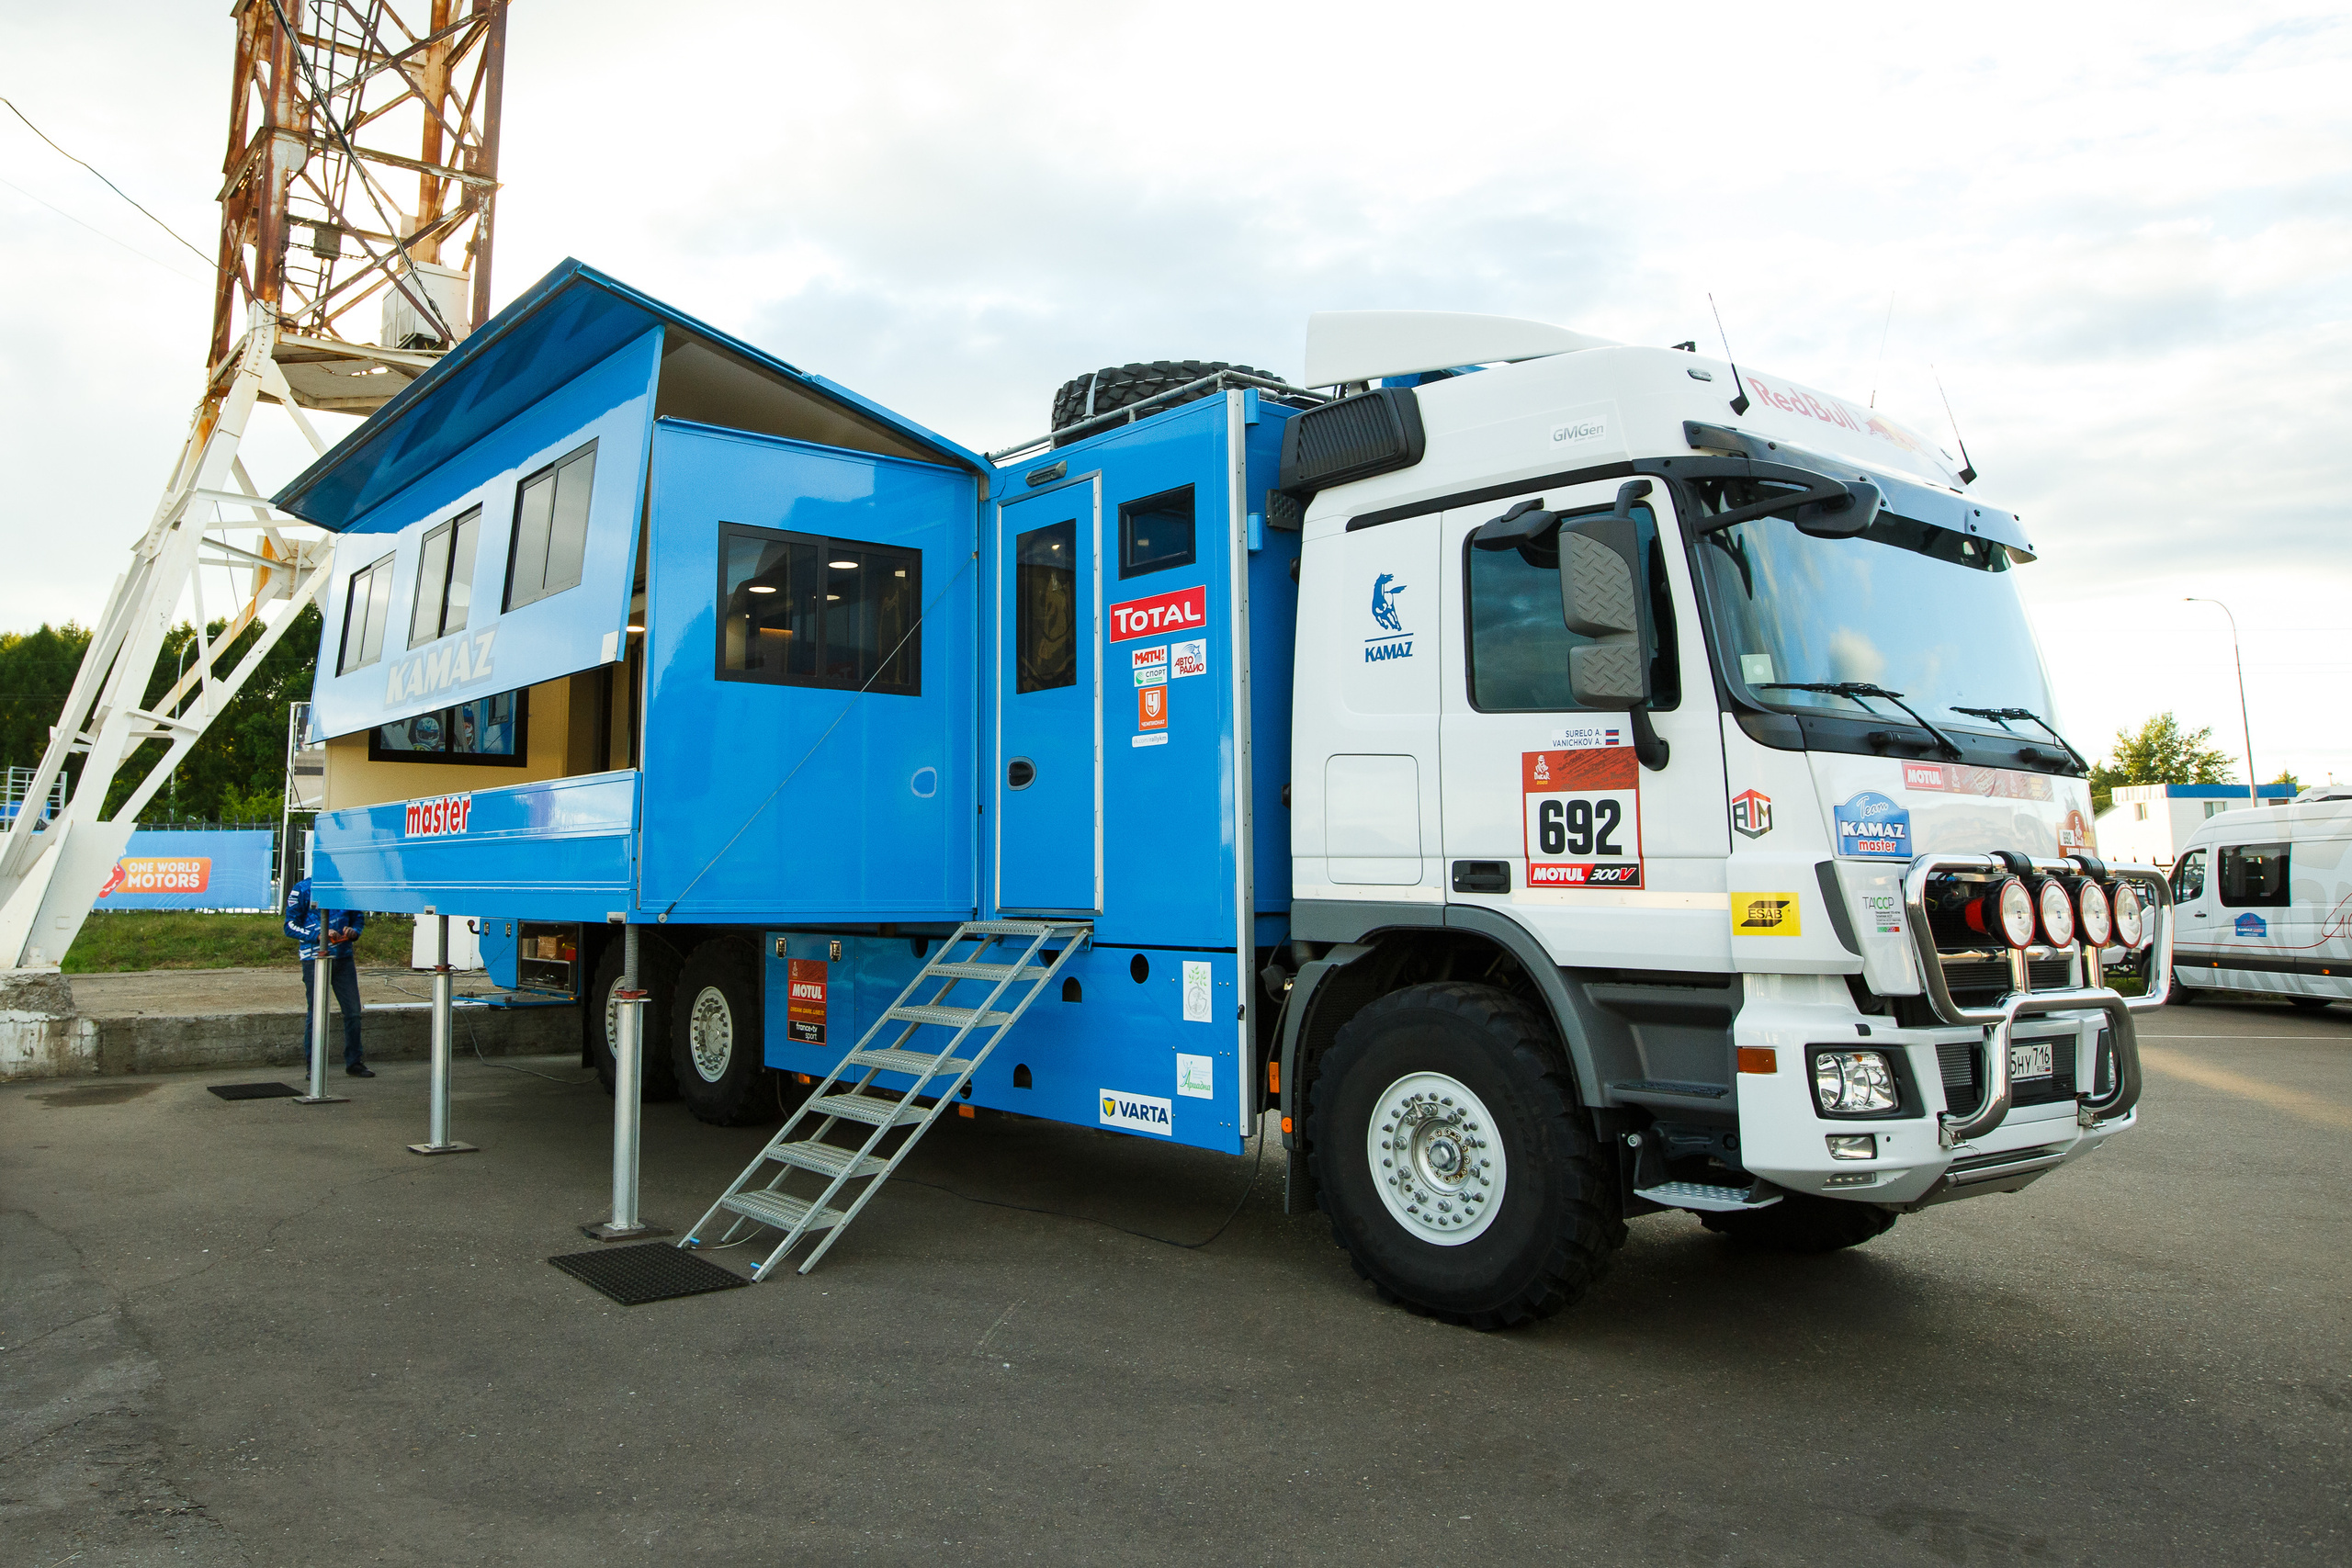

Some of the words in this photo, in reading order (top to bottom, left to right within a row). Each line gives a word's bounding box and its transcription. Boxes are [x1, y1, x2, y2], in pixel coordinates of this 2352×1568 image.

[1747, 377, 1813, 418] Red
[1801, 392, 1860, 433] Bull
[1553, 423, 1604, 442] GMGen
[1114, 601, 1201, 634] TOTAL
[1135, 649, 1165, 665] МАТЧ!
[1365, 641, 1413, 662] KAMAZ
[385, 626, 499, 707] KAMAZ
[1174, 656, 1193, 667] АВТО
[1180, 663, 1204, 674] РАДИО
[1146, 669, 1166, 678] СПОРТ
[1141, 719, 1166, 728] ЧЕМПИОНАТ
[1566, 729, 1593, 738] SURELO
[1595, 728, 1602, 737] A.
[1552, 739, 1593, 748] VANICHKOV
[1595, 738, 1602, 746] A.
[1907, 769, 1942, 785] MOTUL
[1856, 795, 1889, 818] Team
[405, 796, 471, 838] master
[1540, 799, 1623, 855] 692
[1841, 821, 1905, 839] KAMAZ
[1858, 839, 1896, 852] master
[128, 862, 153, 873] ONE
[157, 862, 200, 873] WORLD
[1532, 867, 1585, 882] MOTUL
[1590, 867, 1637, 881] 300V
[128, 874, 200, 888] MOTORS
[1747, 908, 1782, 919] ESAB
[792, 983, 823, 999] MOTUL
[805, 1032, 818, 1041] sport
[2033, 1047, 2050, 1066] 716
[1180, 1068, 1211, 1091] Ариадна
[1119, 1100, 1169, 1124] VARTA
